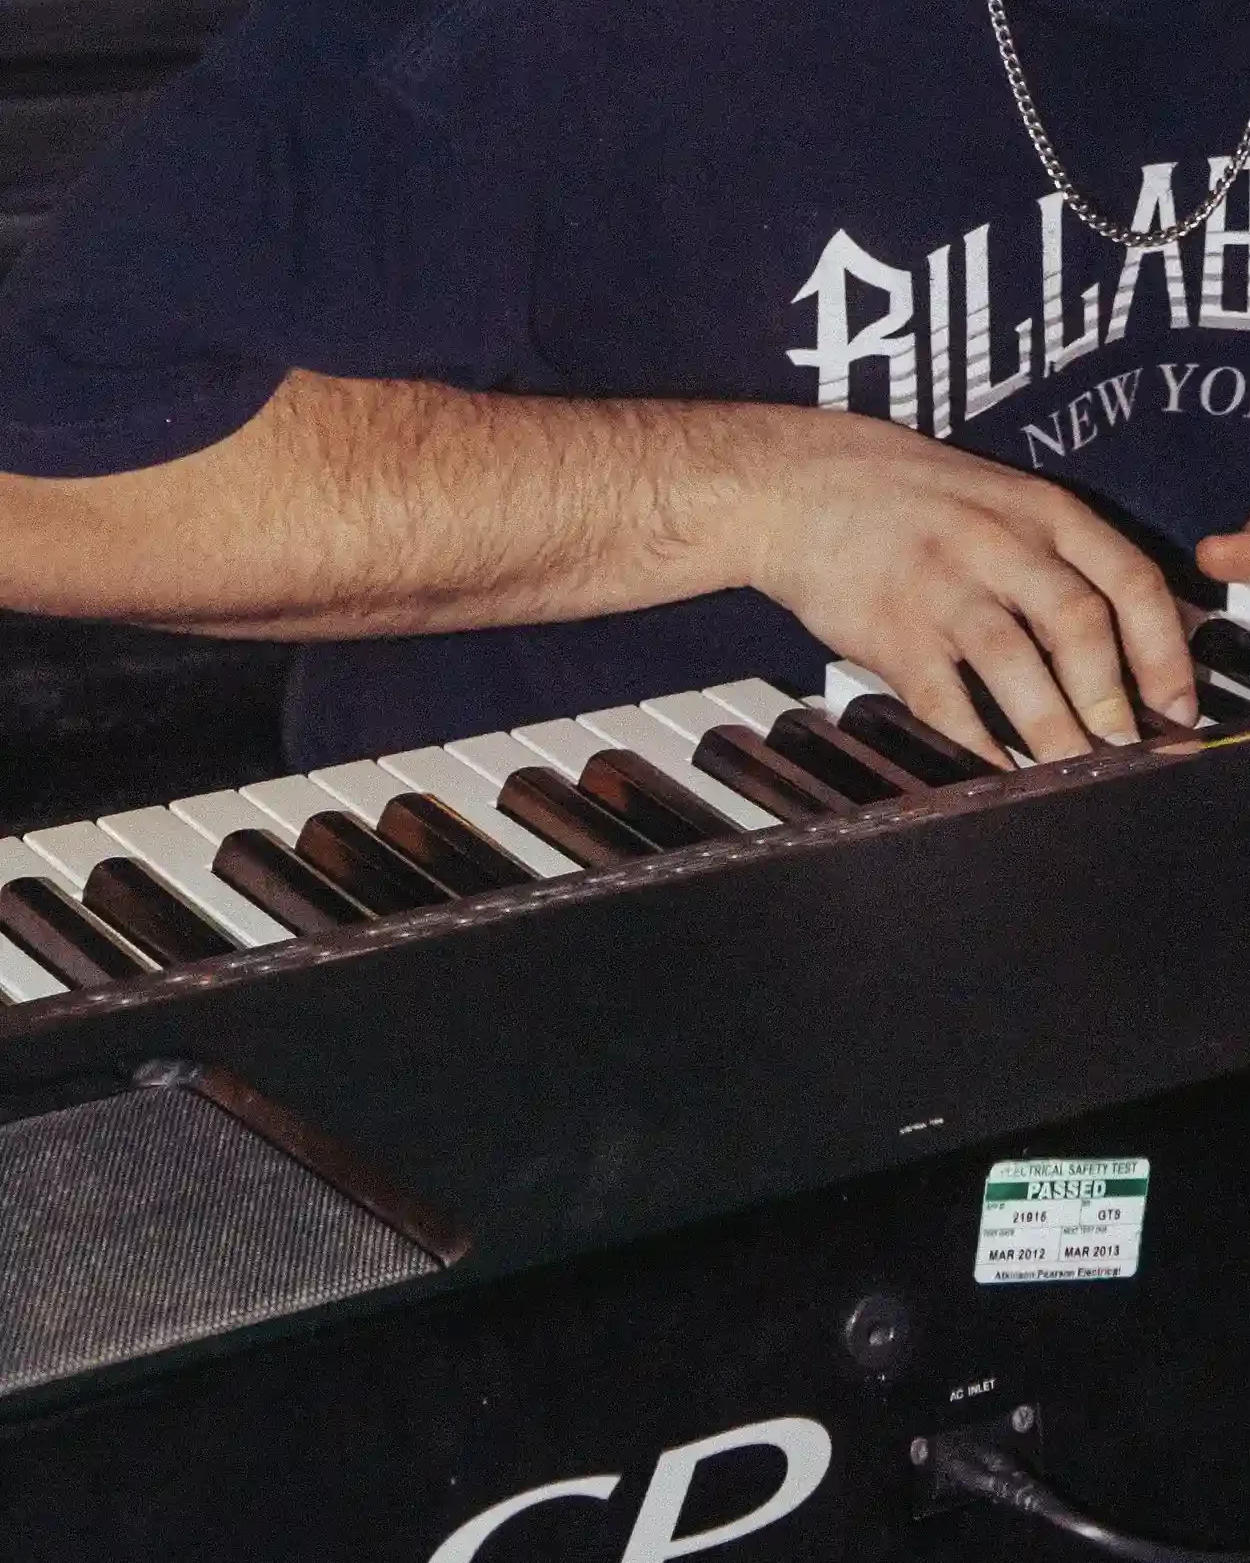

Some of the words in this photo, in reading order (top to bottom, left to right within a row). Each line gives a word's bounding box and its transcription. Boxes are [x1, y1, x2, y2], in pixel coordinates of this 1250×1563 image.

[1020, 367, 1144, 469] NEW
[1068, 1162, 1109, 1176] SAFETY
[1113, 1161, 1138, 1175] TEST
[1027, 1179, 1107, 1200] PASSED
[989, 1249, 1015, 1261] MAR
[1018, 1247, 1046, 1260] 2012
[1064, 1246, 1090, 1258] MAR
[1093, 1244, 1120, 1257] 2013
[949, 1388, 965, 1402] AC
[967, 1378, 996, 1397] INLET
